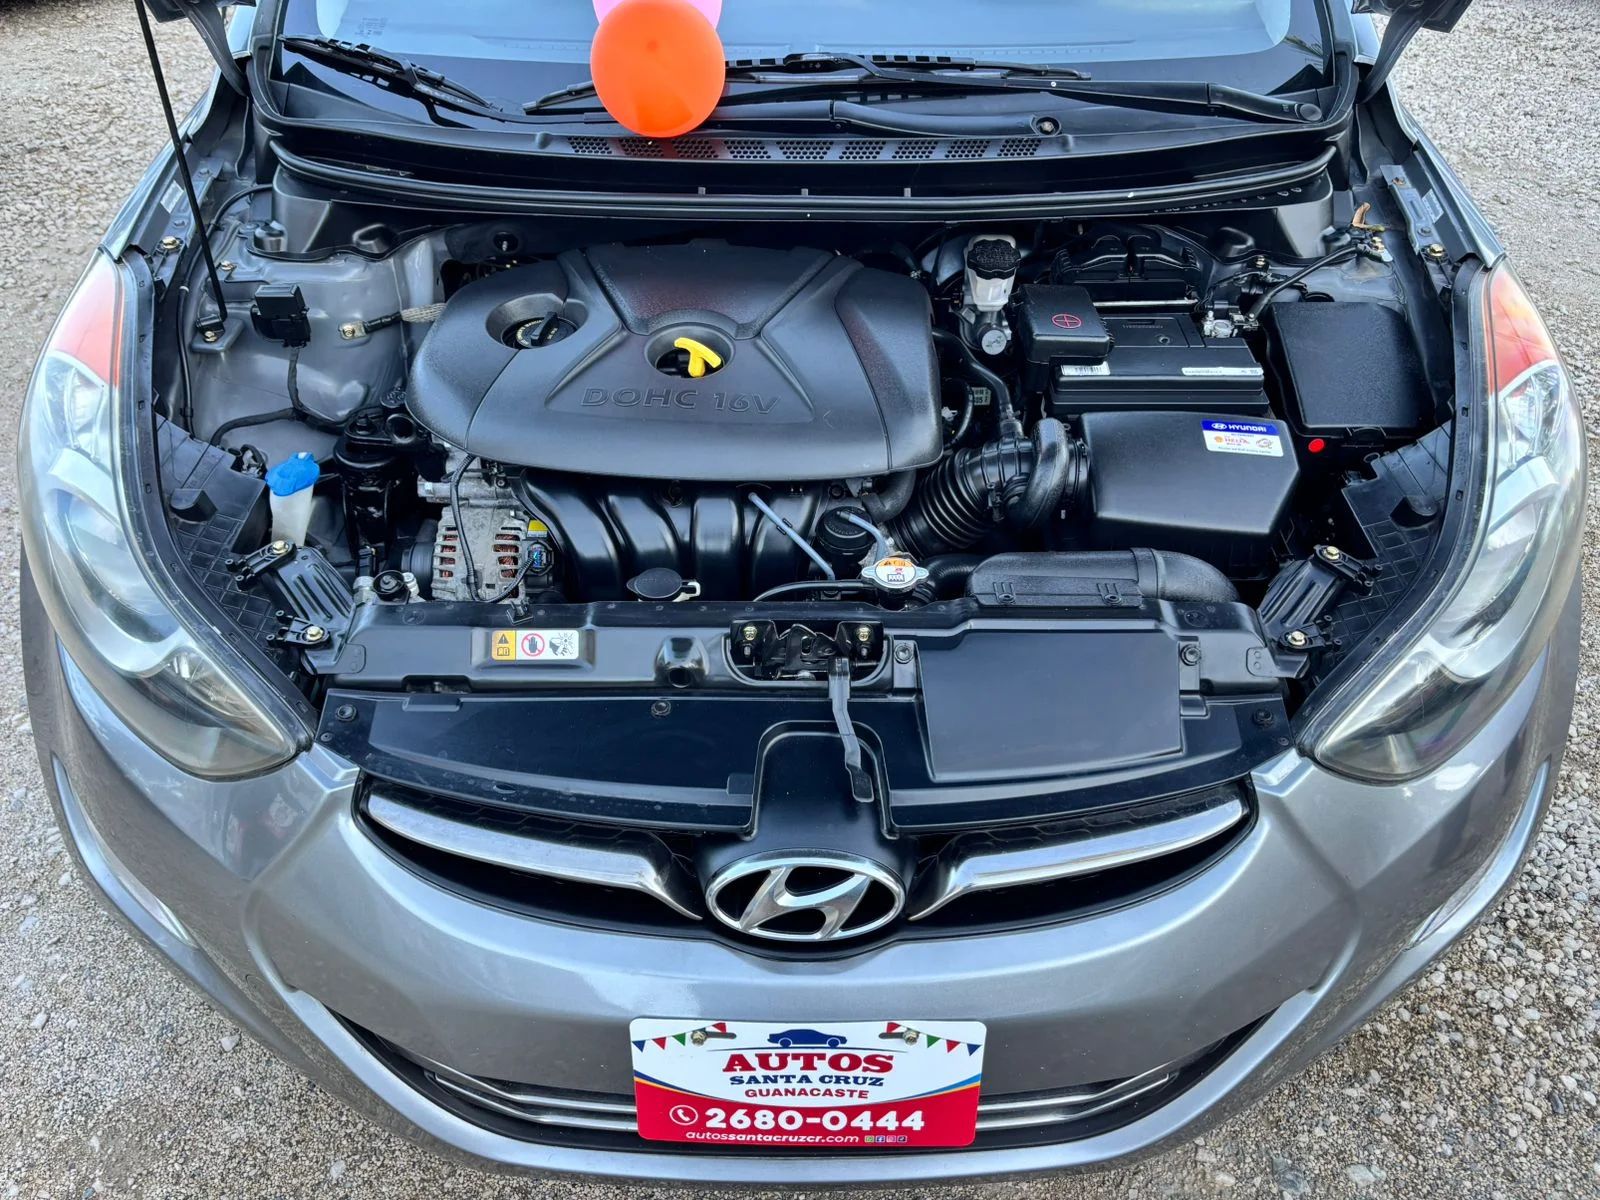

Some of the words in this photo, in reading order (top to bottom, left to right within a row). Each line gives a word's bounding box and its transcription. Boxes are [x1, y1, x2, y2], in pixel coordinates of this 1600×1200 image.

[581, 387, 699, 409] DOHC
[713, 391, 780, 414] 16V
[1228, 424, 1267, 432] HYUNDAI
[722, 1052, 894, 1073] AUTOS
[730, 1074, 813, 1086] SANTA
[819, 1074, 885, 1087] CRUZ
[744, 1087, 870, 1099] GUANACASTE
[704, 1107, 925, 1131] 2680-0444
[685, 1130, 860, 1144] autossantacruzcr.com
